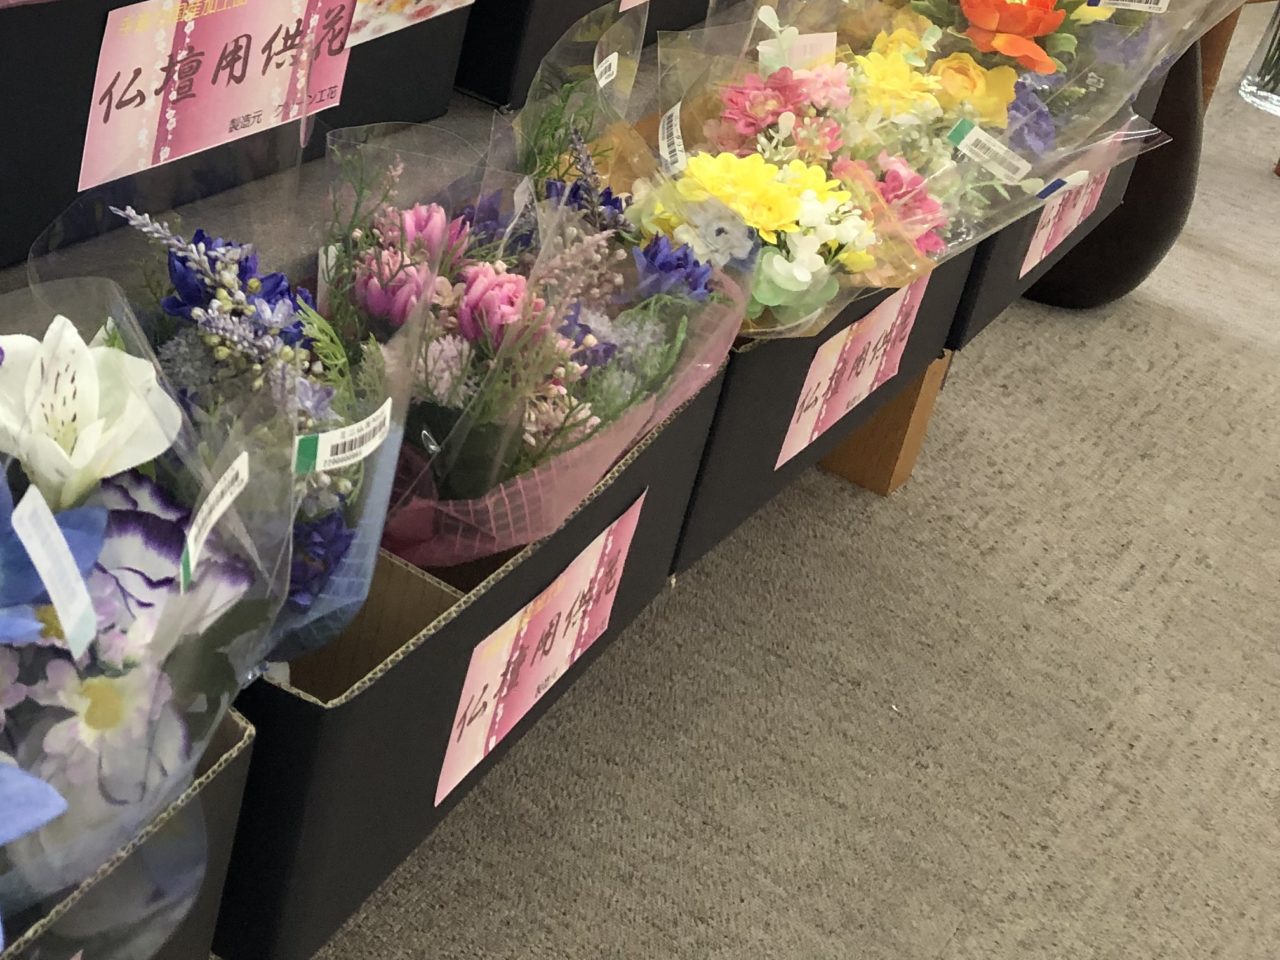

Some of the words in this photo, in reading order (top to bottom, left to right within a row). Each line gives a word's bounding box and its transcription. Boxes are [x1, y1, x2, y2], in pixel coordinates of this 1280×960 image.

[99, 3, 346, 124] 仏壇用供花
[228, 109, 263, 133] 製造元
